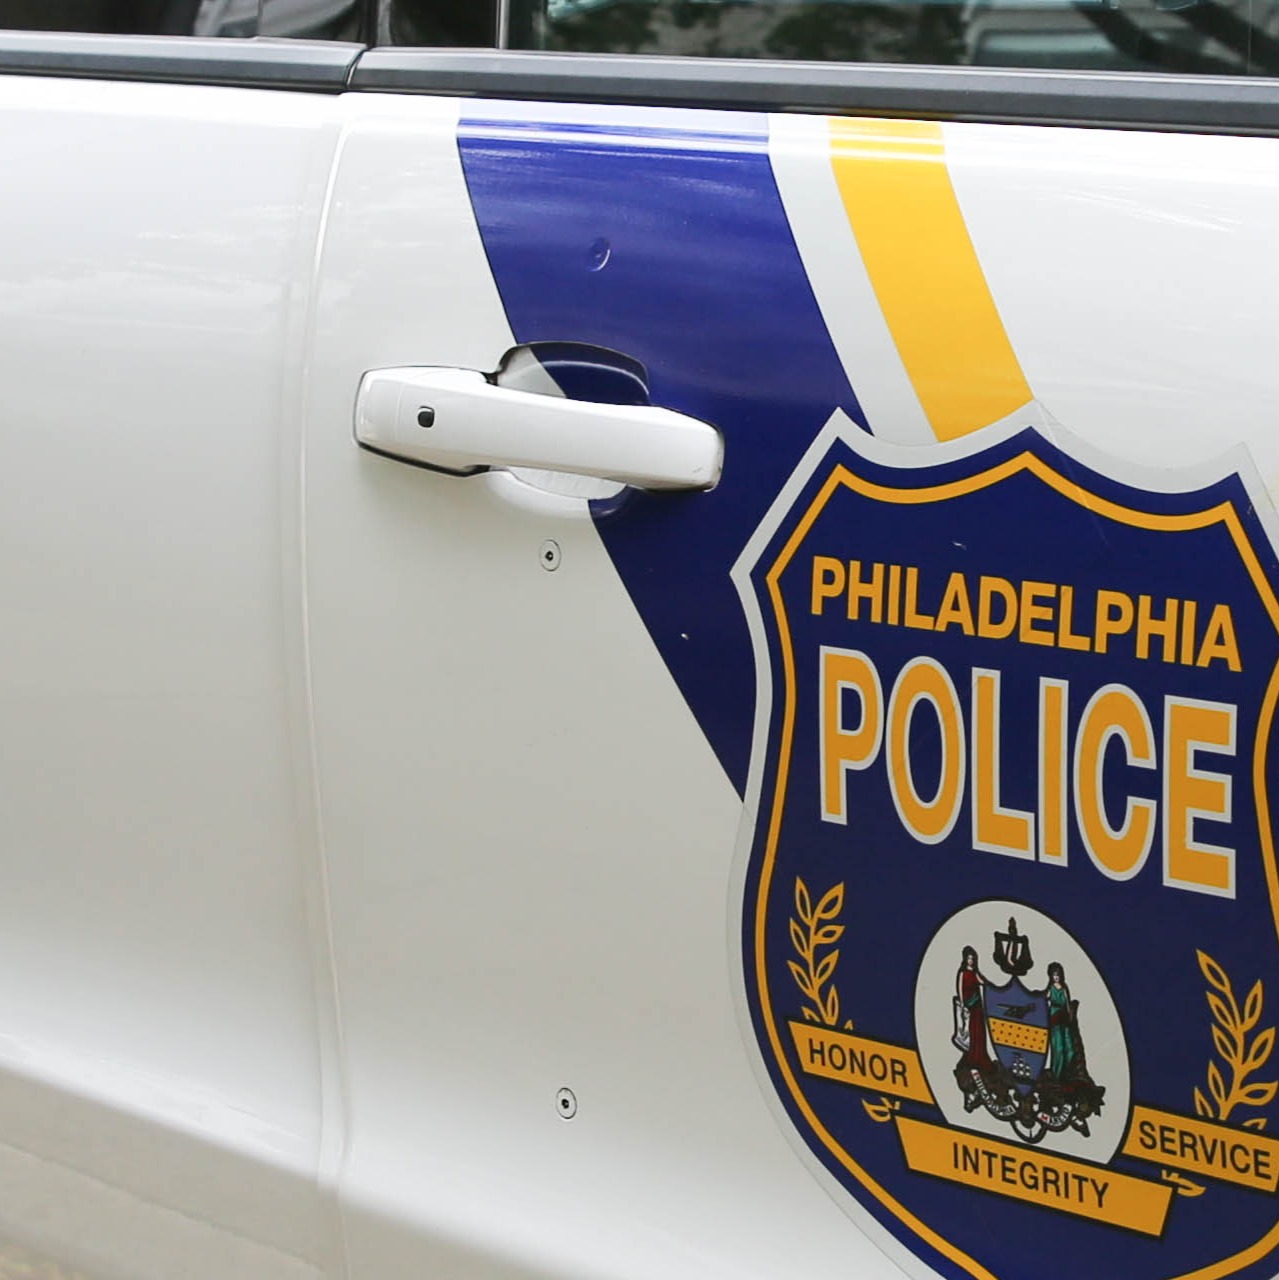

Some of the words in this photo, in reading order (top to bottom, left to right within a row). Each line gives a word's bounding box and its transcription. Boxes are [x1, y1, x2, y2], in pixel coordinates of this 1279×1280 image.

[811, 555, 1243, 672] PHILADELPHIA
[819, 644, 1237, 900] POLICE
[808, 1038, 909, 1088] HONOR
[952, 1141, 1110, 1209] INTEGRITY
[1138, 1120, 1273, 1181] SERVICE
